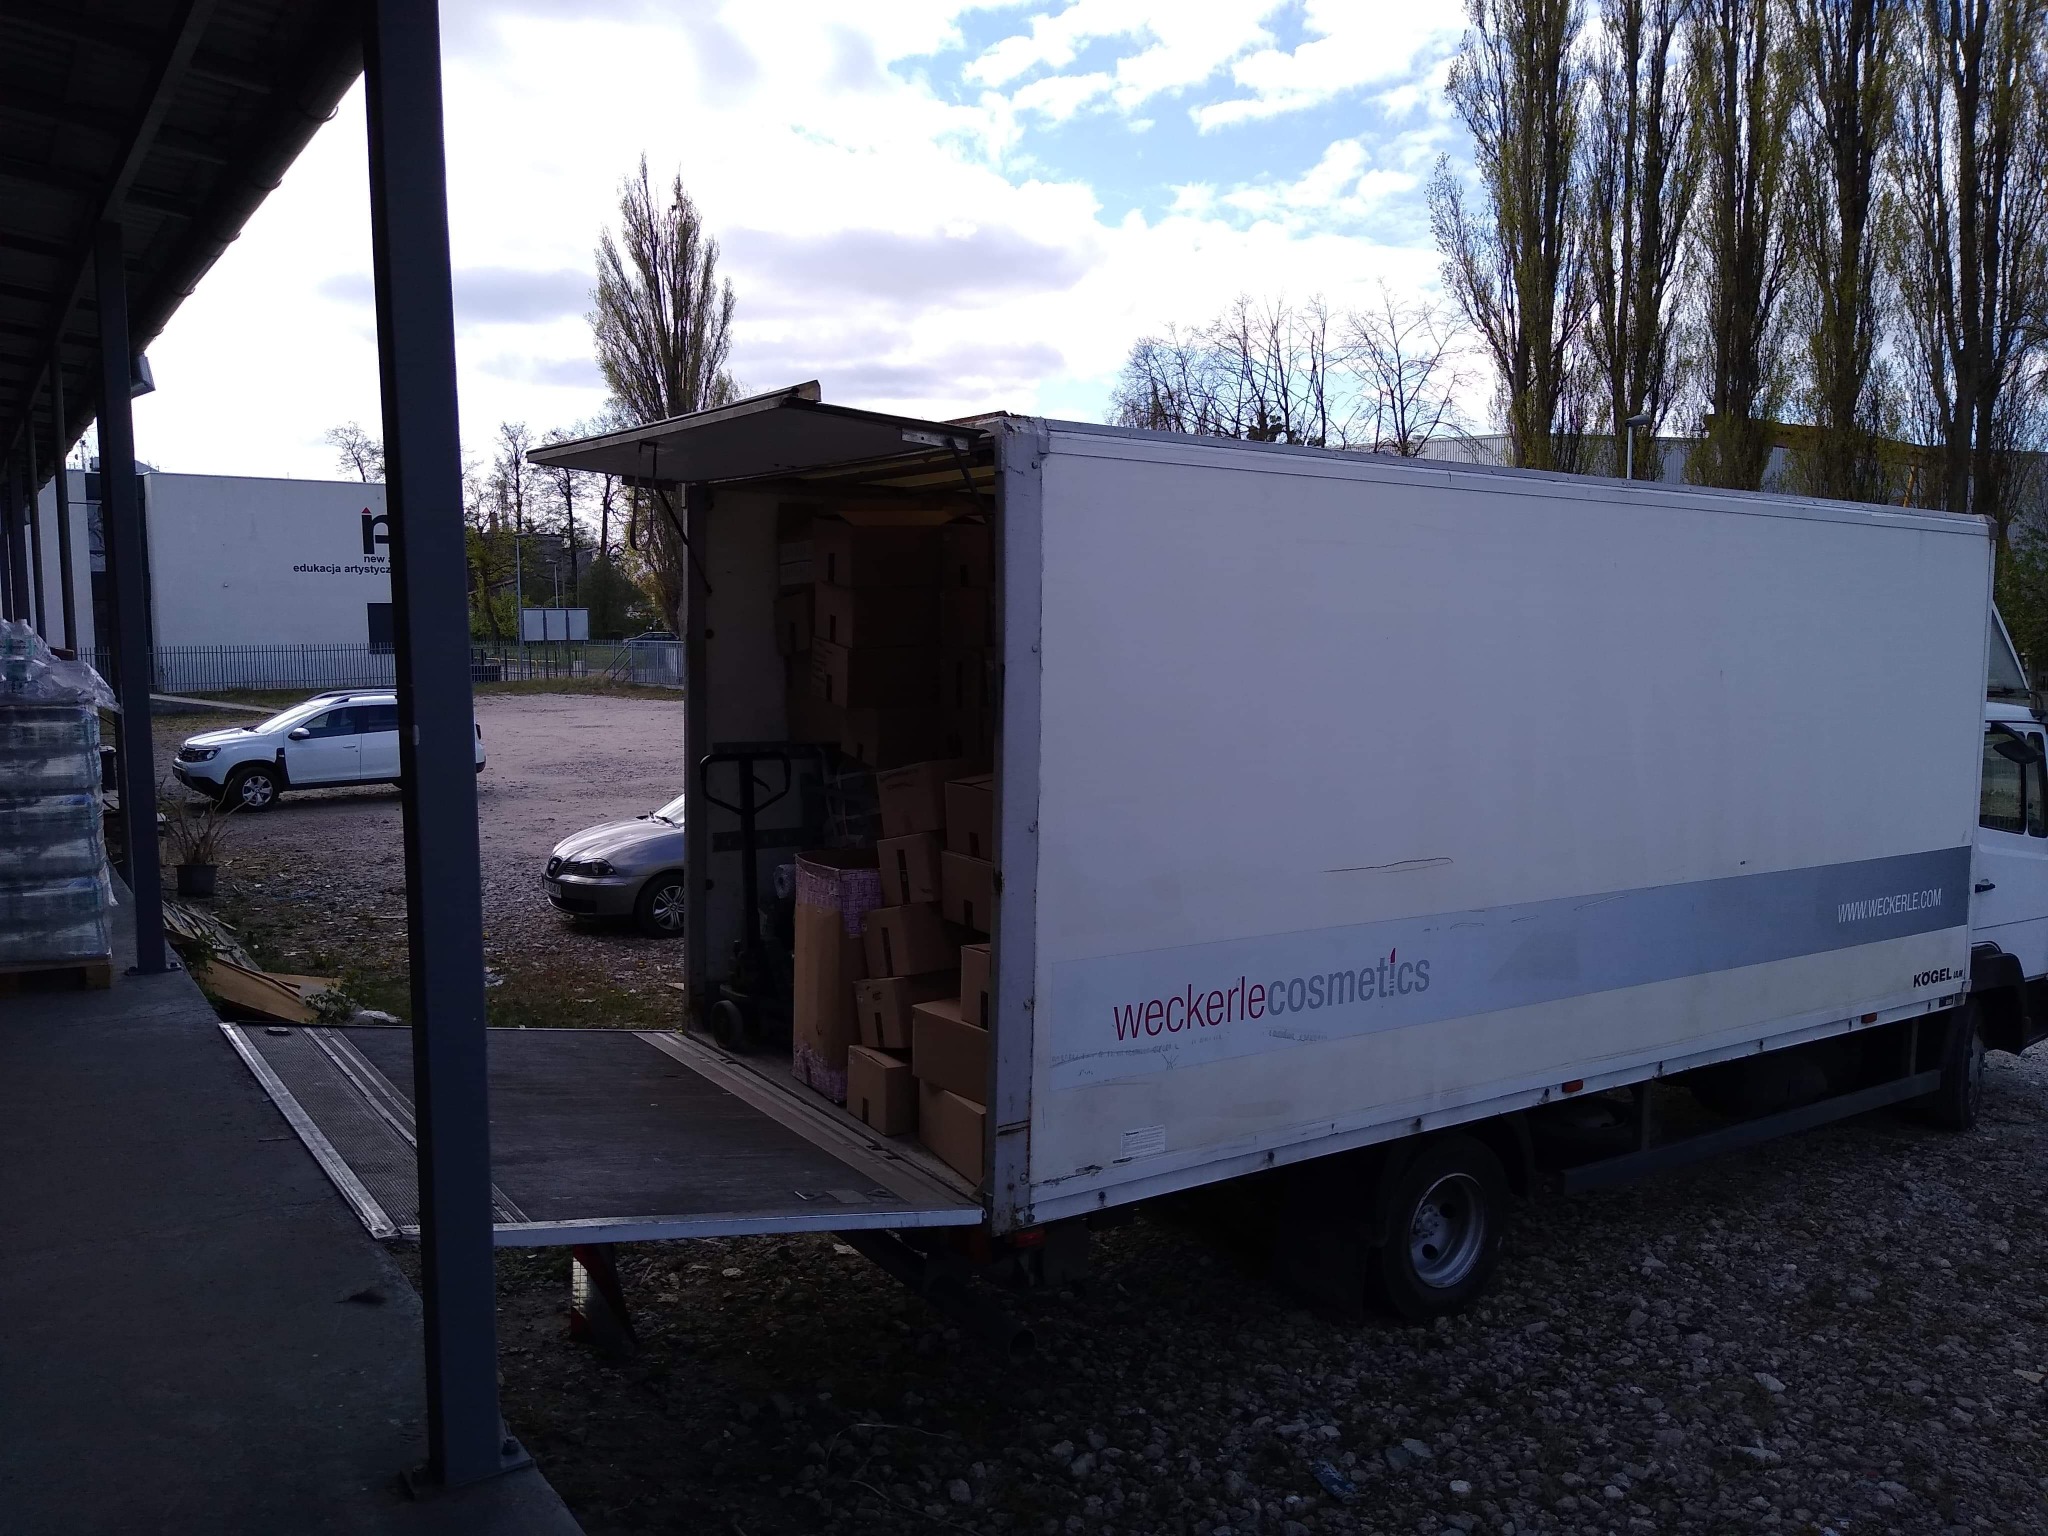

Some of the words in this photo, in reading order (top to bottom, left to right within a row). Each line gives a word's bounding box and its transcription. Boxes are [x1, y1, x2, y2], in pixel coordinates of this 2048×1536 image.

[363, 555, 385, 563] new
[293, 563, 341, 575] edukacja
[1838, 888, 1942, 923] WWW.WECKERLE.COM
[1913, 967, 1952, 988] KÖGEL
